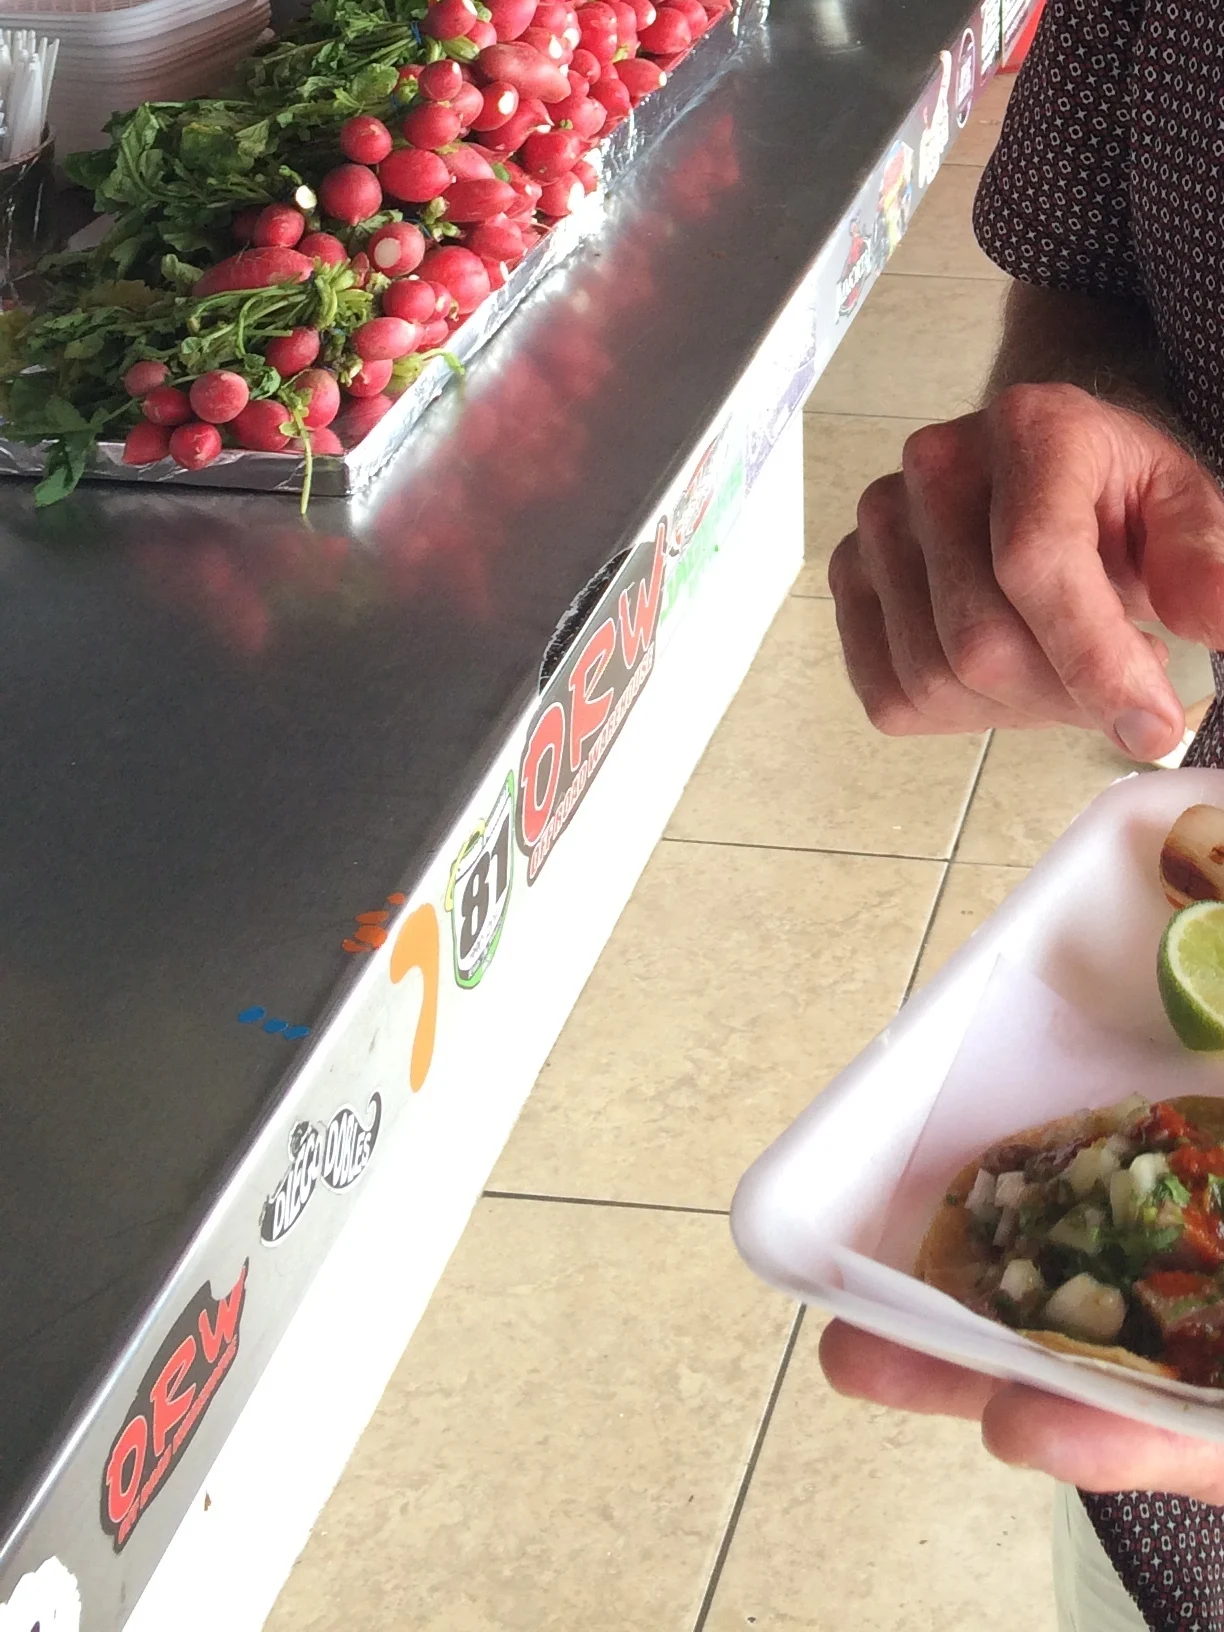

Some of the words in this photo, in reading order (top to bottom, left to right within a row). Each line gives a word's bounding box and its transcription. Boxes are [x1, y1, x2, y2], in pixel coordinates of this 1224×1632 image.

[521, 522, 666, 847] ORW
[460, 812, 510, 960] 81
[323, 1111, 372, 1187] DOBLES
[106, 1265, 246, 1524] ORW
